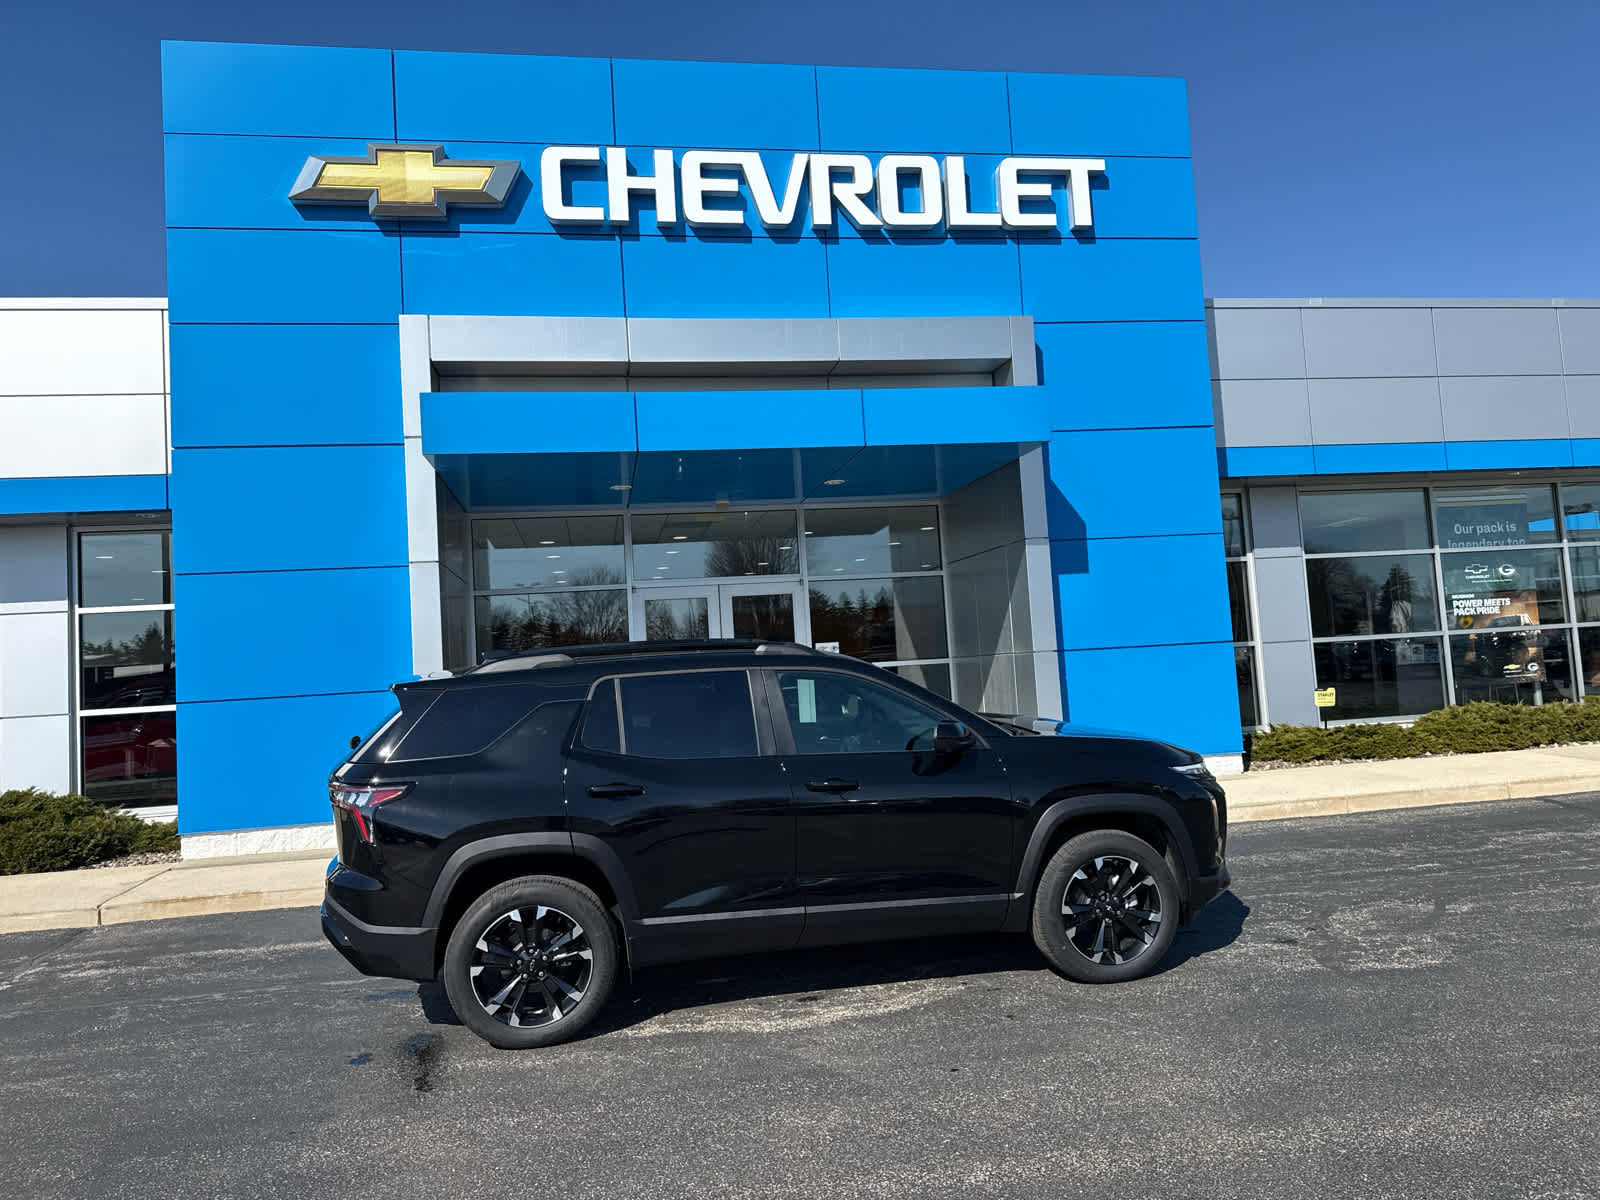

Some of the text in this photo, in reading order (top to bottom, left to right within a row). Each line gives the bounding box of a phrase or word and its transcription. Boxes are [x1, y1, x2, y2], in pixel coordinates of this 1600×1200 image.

[540, 145, 1106, 231] CHEVROLET
[1454, 520, 1517, 536] Our pack is
[1452, 597, 1511, 608] POWER MEETS
[1453, 606, 1501, 617] PACK PRIDE
